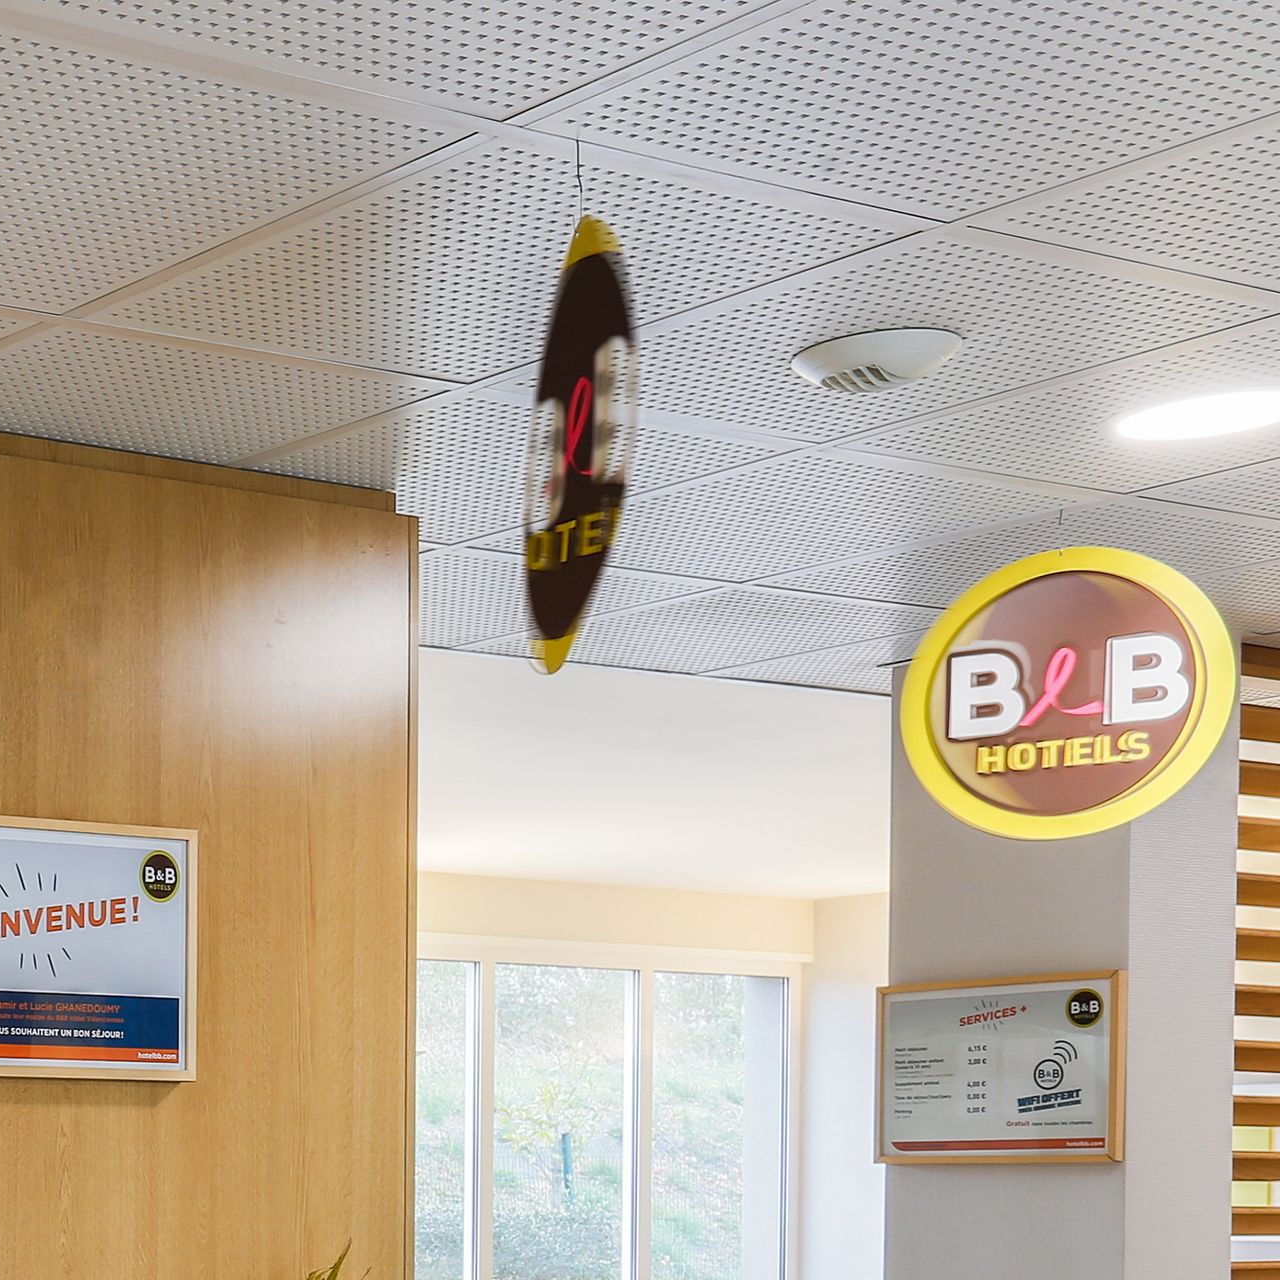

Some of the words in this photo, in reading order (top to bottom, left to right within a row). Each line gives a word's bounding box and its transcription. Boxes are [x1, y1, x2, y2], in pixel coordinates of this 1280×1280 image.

[976, 730, 1151, 776] HOTELS
[144, 866, 176, 884] B&B
[19, 1002, 28, 1010] et
[30, 1002, 54, 1012] Lucie
[1070, 1000, 1100, 1014] B&B
[959, 1006, 1017, 1027] SERVICES
[10, 1027, 59, 1037] SOUHAITENT
[60, 1029, 72, 1037] UN
[73, 1030, 91, 1038] BON
[1037, 1069, 1060, 1079] B&B
[1041, 1088, 1082, 1103] OFFERT
